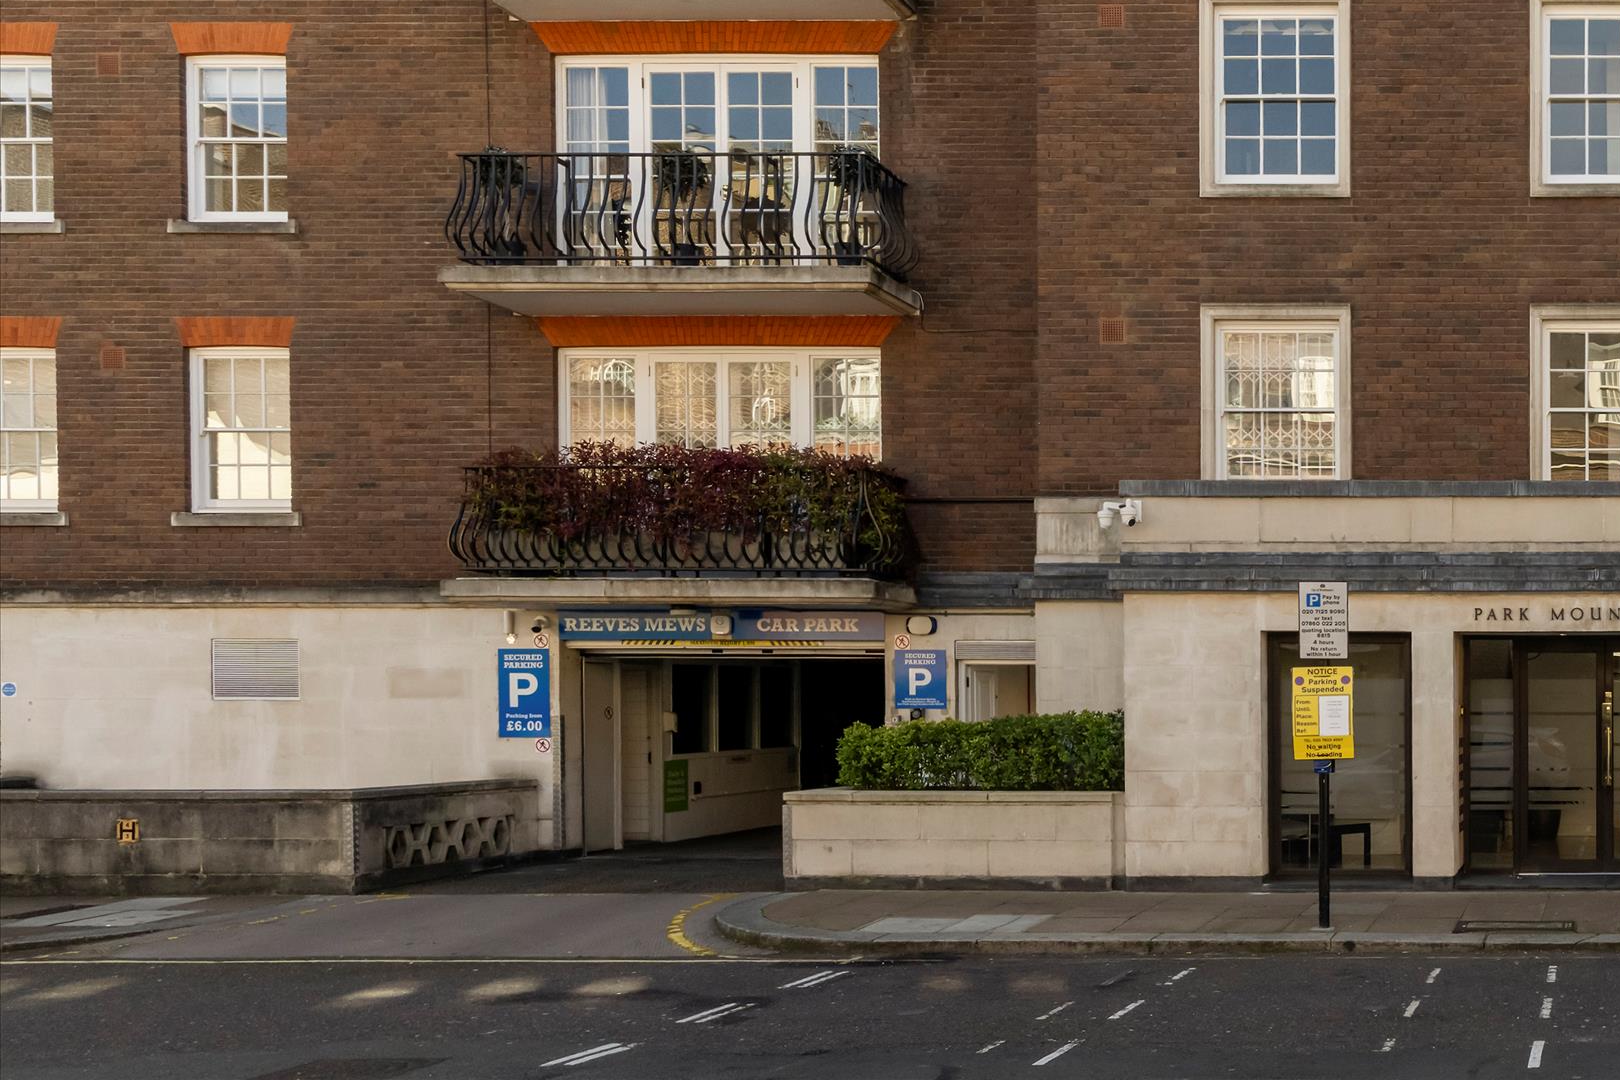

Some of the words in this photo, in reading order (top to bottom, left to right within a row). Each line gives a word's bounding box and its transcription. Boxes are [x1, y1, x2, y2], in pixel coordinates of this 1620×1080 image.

[1310, 594, 1318, 606] P
[1474, 608, 1530, 621] PARK
[564, 618, 640, 632] REEVES
[644, 618, 706, 632] MEWS
[756, 618, 800, 632] CAR
[804, 618, 858, 632] PARK
[909, 668, 932, 695] P
[509, 672, 538, 708] P
[506, 721, 542, 731] £6.00
[120, 822, 135, 840] H
